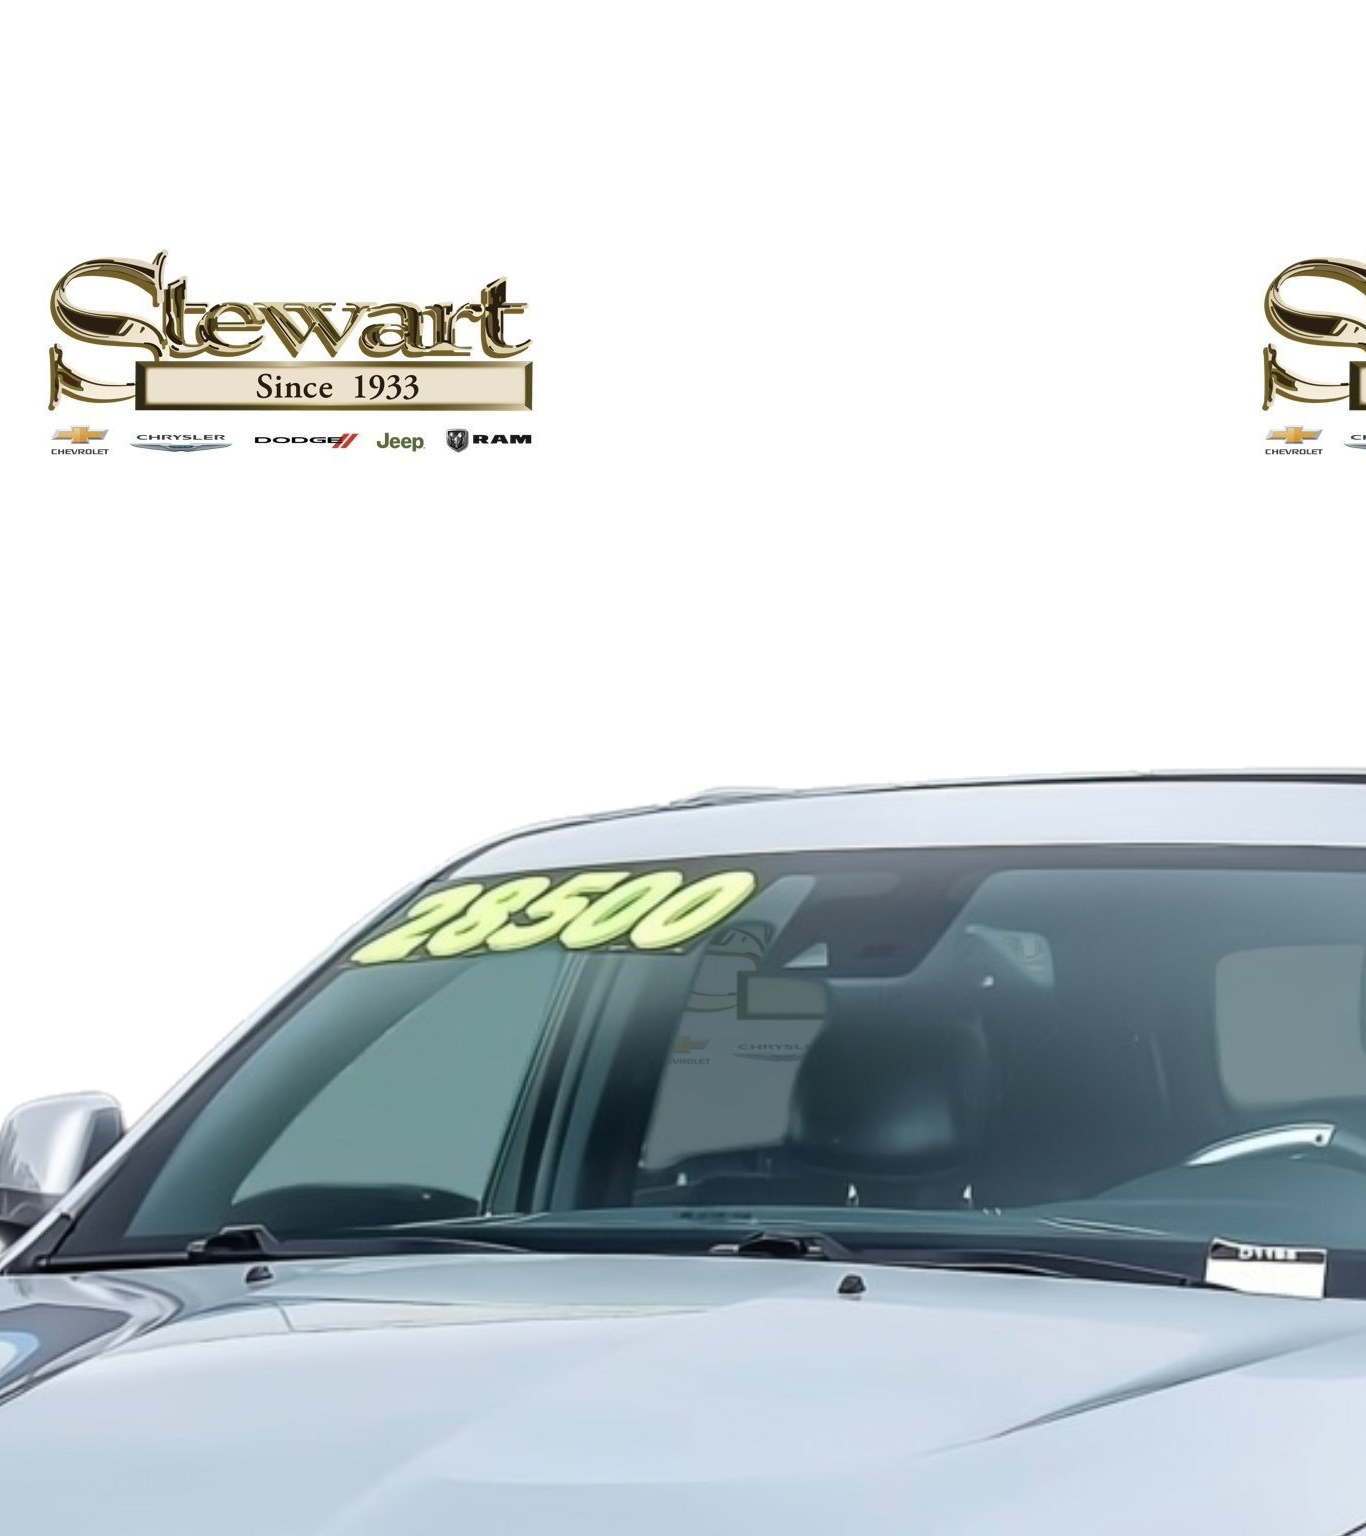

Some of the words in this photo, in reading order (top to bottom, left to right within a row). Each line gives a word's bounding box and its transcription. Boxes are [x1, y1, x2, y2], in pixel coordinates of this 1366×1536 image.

[48, 249, 532, 410] Stewart
[256, 373, 333, 399] Since
[354, 374, 420, 401] 1933
[376, 432, 425, 451] Jeep
[473, 434, 532, 444] RAM
[351, 870, 757, 963] 28500
